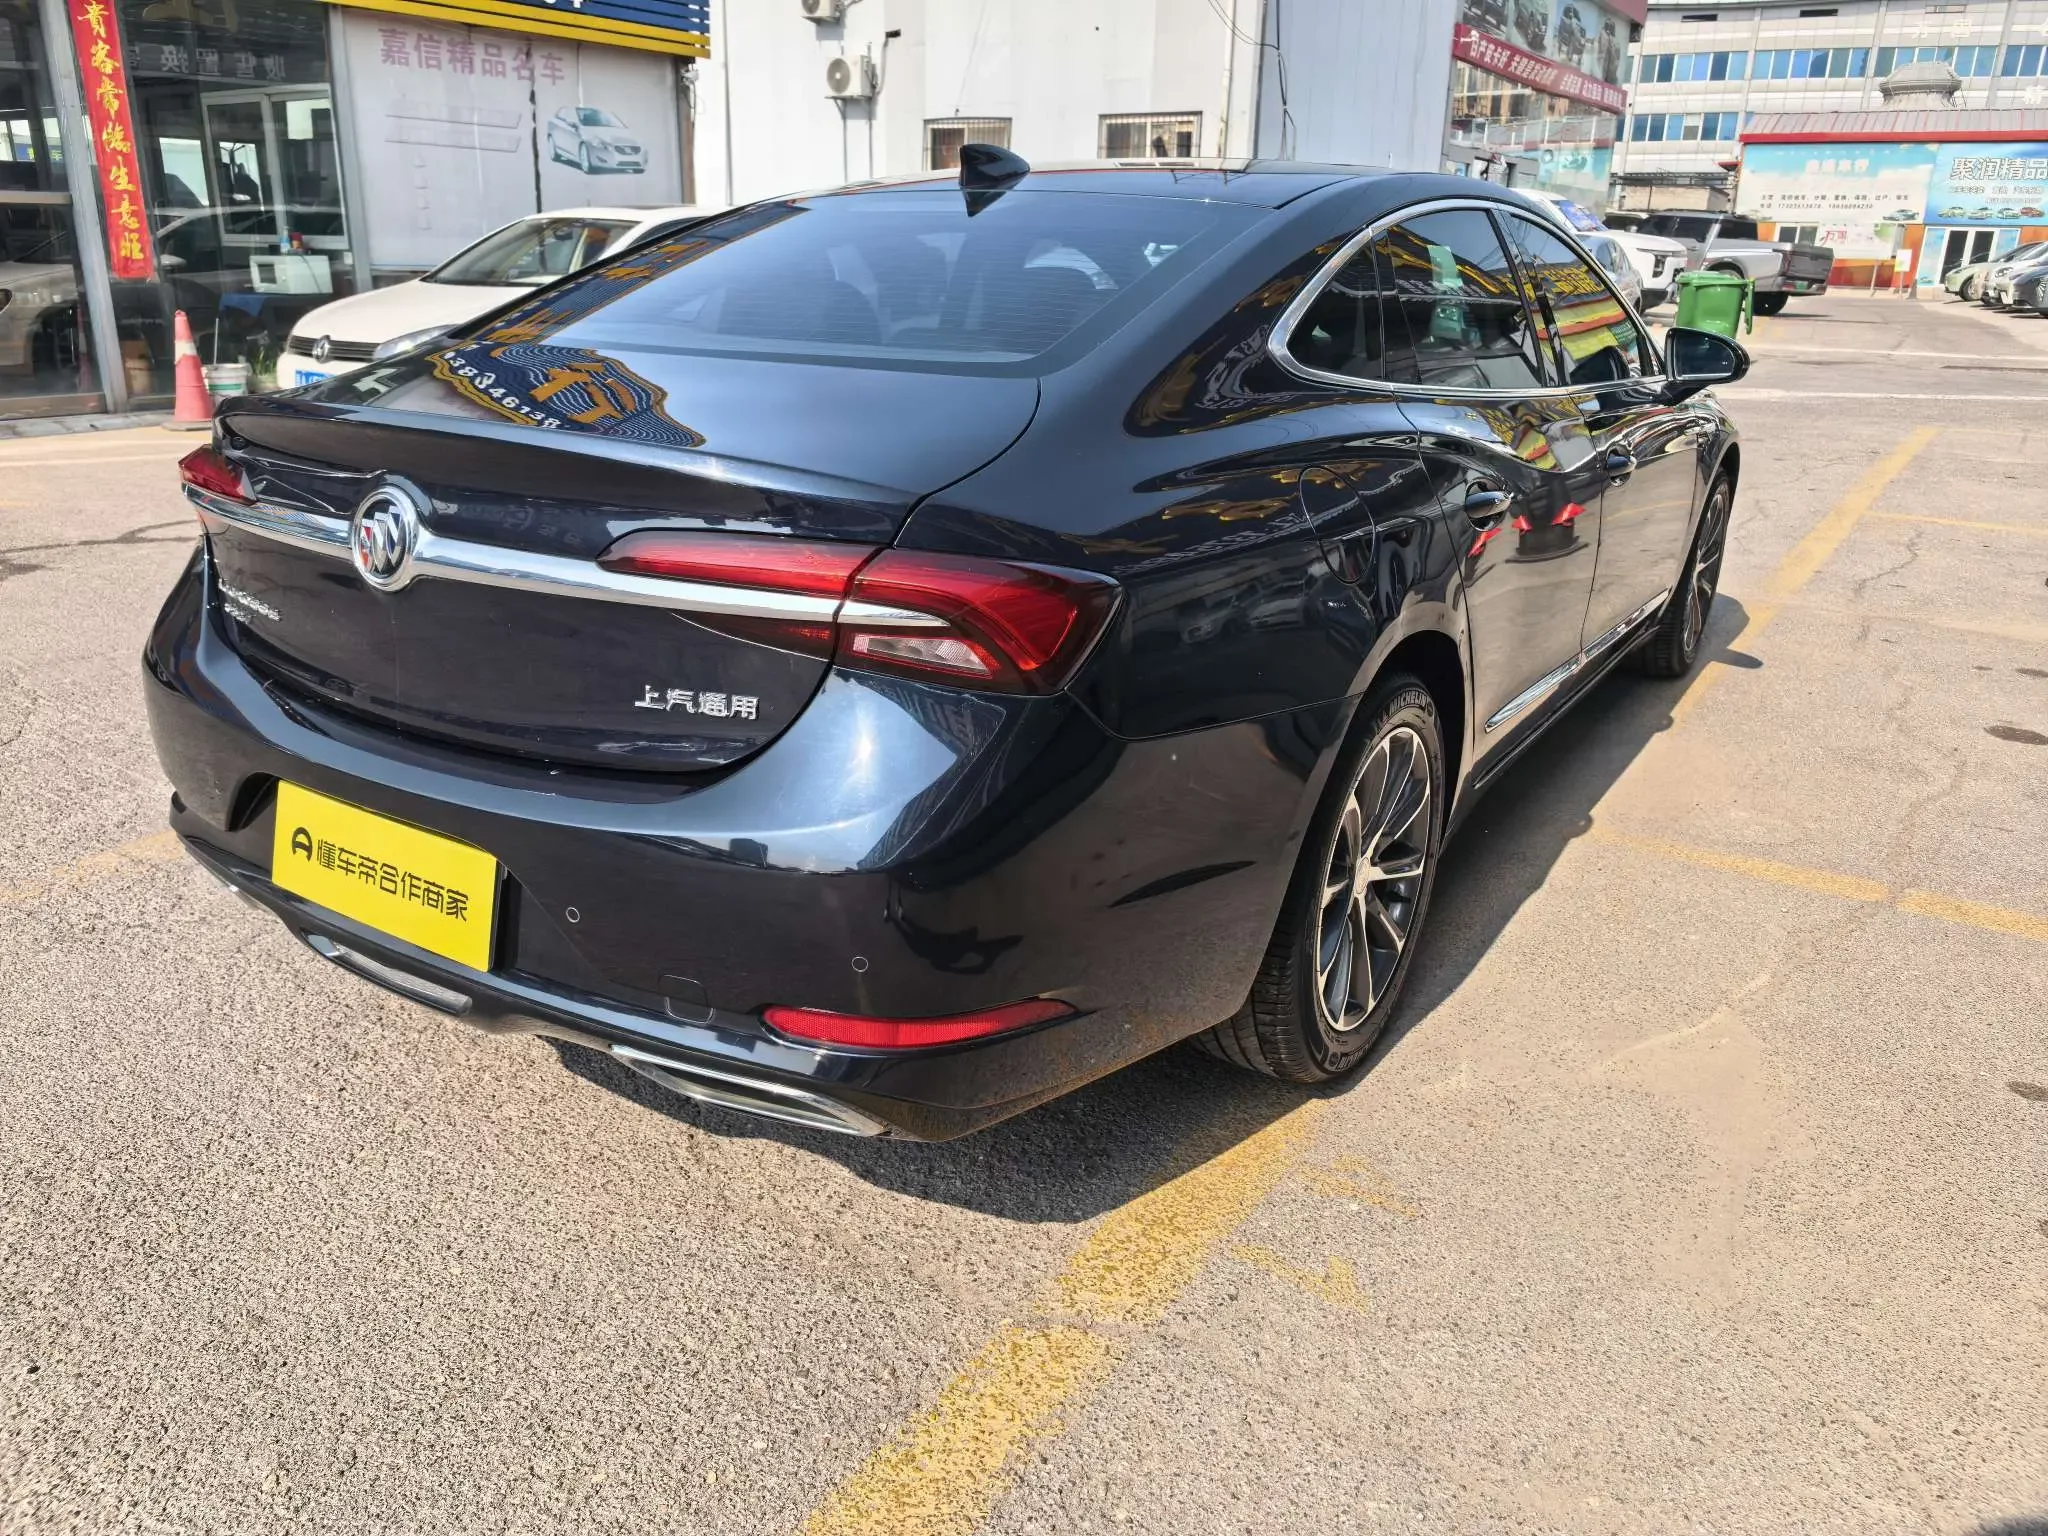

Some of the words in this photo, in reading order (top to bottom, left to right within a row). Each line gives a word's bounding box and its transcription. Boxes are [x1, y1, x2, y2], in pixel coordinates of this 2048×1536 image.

[377, 28, 565, 86] 嘉信精品名车
[1949, 157, 2048, 181] 聚润精品
[634, 684, 760, 720] 上汽通用
[1389, 689, 1428, 714] MICHELIN
[316, 838, 470, 922] 懂车帝合作商家
